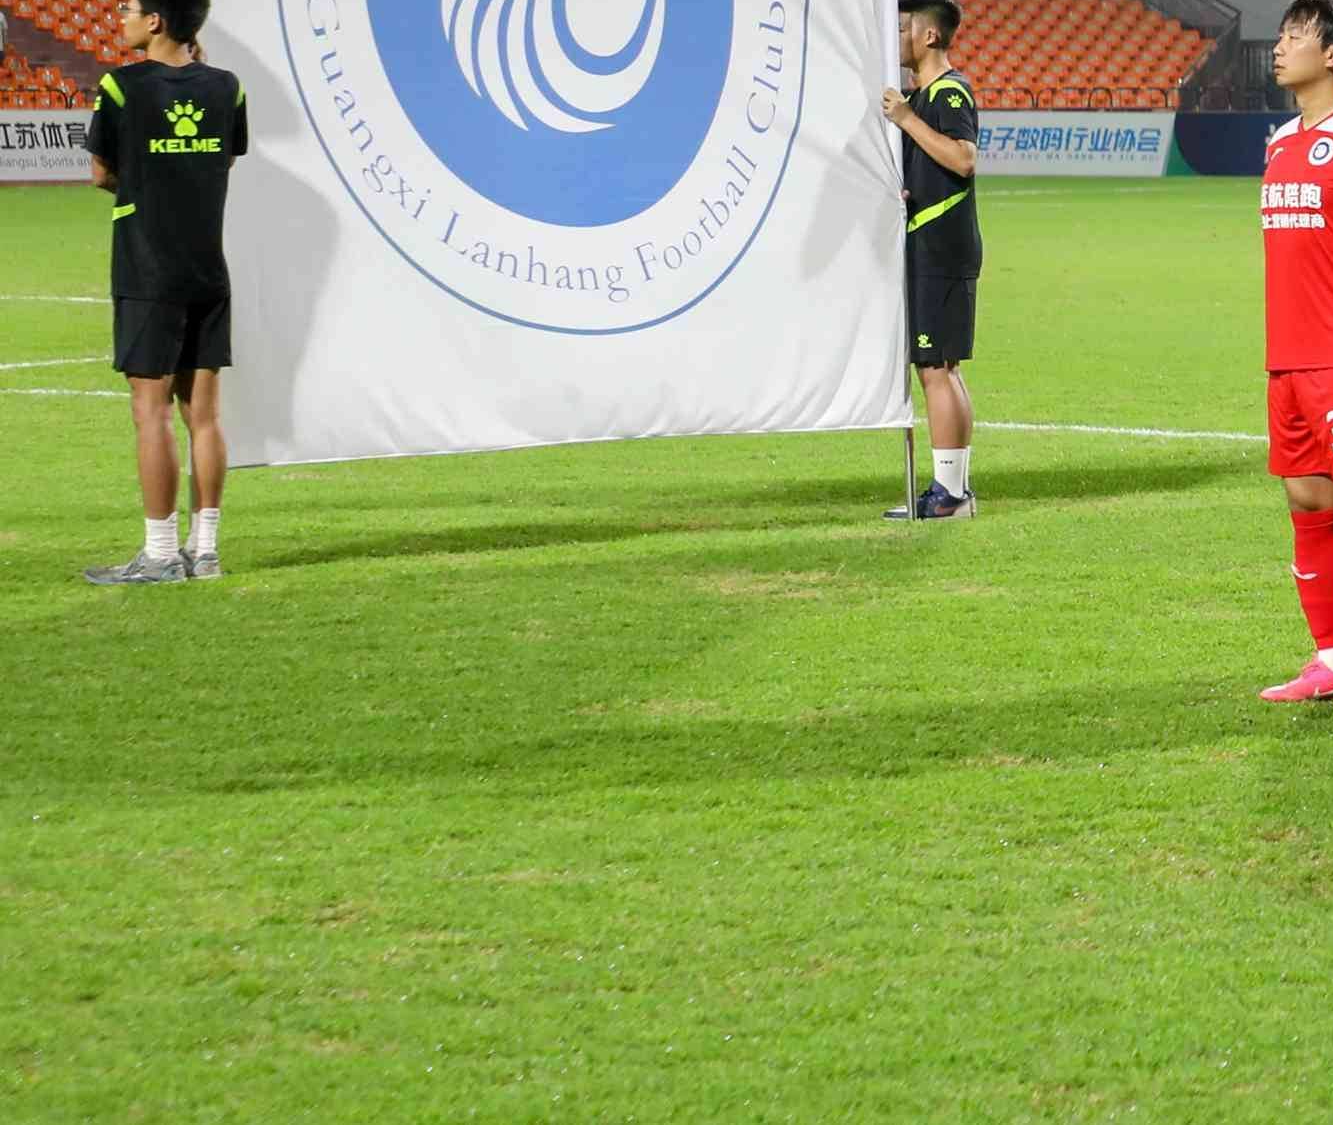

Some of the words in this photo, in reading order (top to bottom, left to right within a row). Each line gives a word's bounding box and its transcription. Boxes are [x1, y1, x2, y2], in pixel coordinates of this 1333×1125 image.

[149, 138, 222, 153] KELME
[441, 210, 631, 304] Lanhang
[635, 145, 759, 283] Football
[745, 0, 786, 135] Club
[977, 127, 1162, 152] 电子数码行业协会
